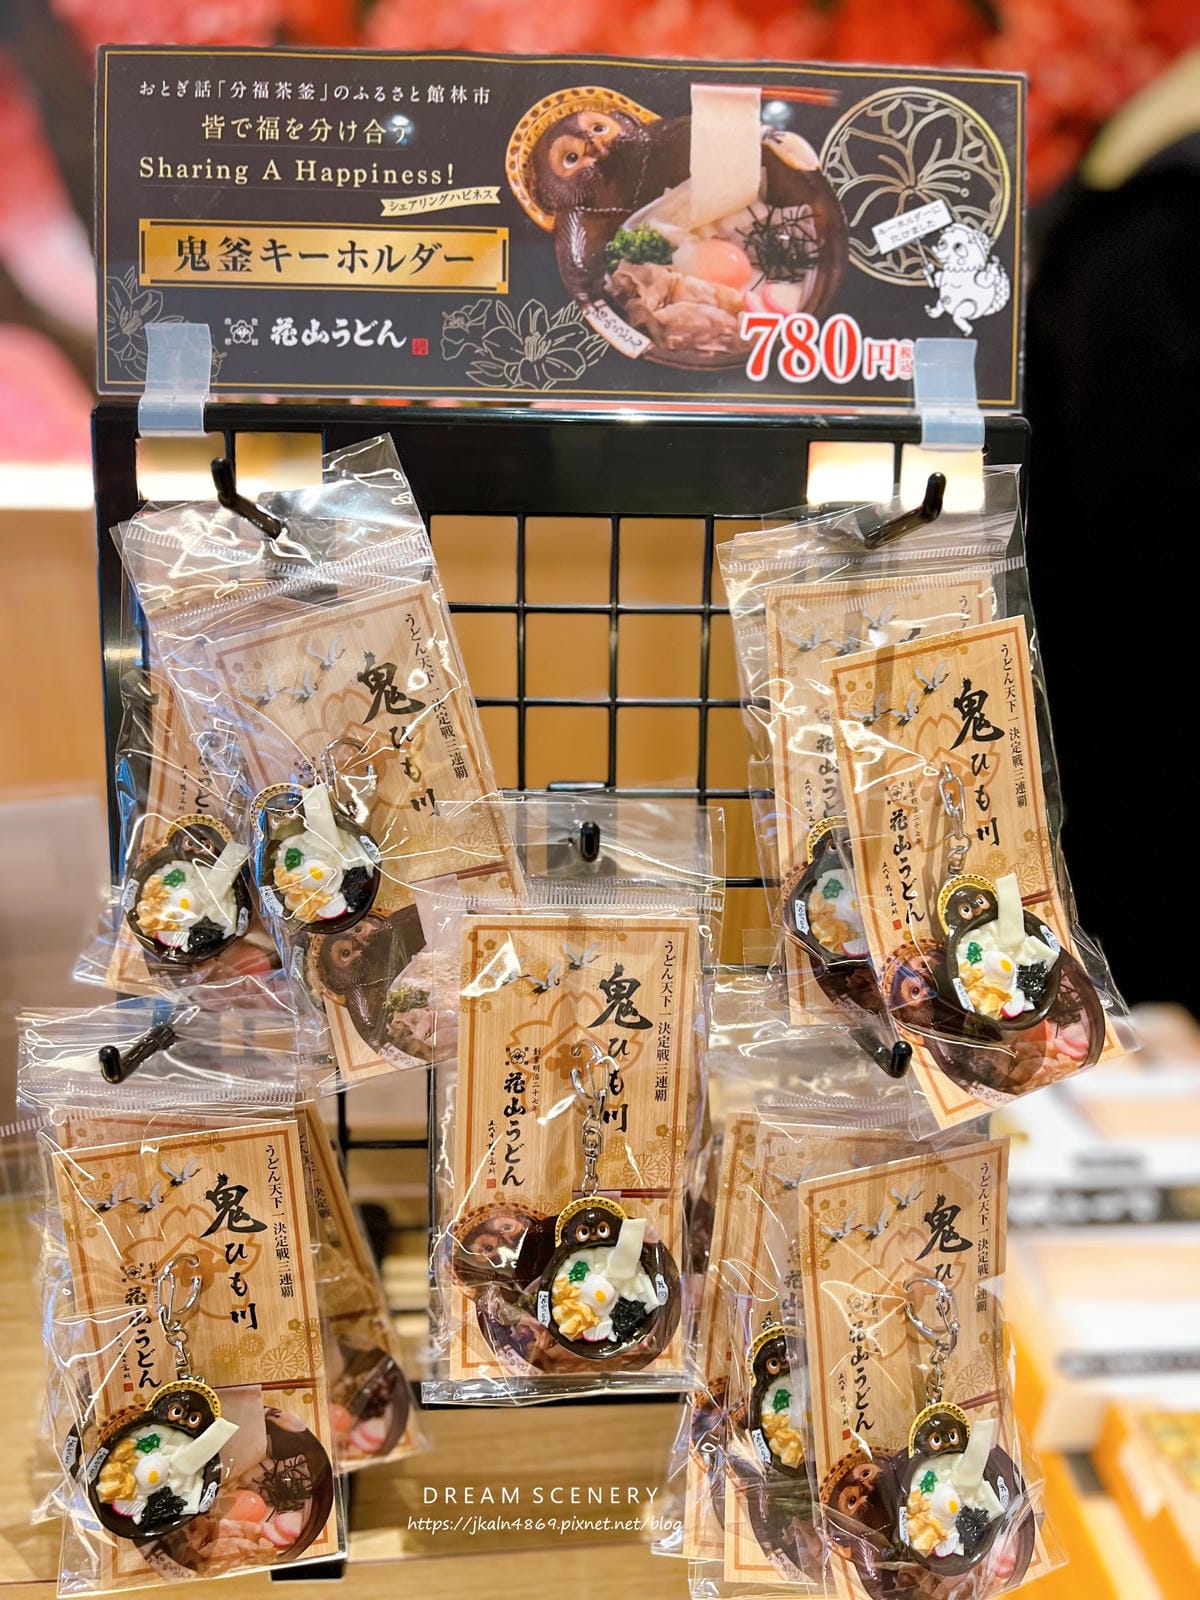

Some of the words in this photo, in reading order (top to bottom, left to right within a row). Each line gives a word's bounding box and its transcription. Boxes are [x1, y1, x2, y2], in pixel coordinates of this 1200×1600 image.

[139, 80, 491, 106] おとぎ話「分福茶釜」のふるさと館林市
[202, 114, 406, 145] 皆で福を分け合う
[139, 158, 249, 184] Sharing
[263, 160, 282, 182] A
[295, 161, 455, 187] Happiness!
[175, 235, 475, 275] 鬼釜キーホルダー
[270, 316, 407, 349] 花山うどん
[949, 678, 1006, 847] 鬼ひも川
[1000, 642, 1028, 808] うどん天下一決定戦三連覇
[890, 808, 926, 924] 花山うどん
[654, 940, 677, 1102] うどん天下一決定戦三連覇
[501, 1071, 526, 1187] 花山うどん
[200, 1172, 268, 1330] 鬼ひも川
[264, 1143, 295, 1298] うどん天下一決定戦三連覇
[975, 1162, 992, 1313] うどん天下一決定戦連覇
